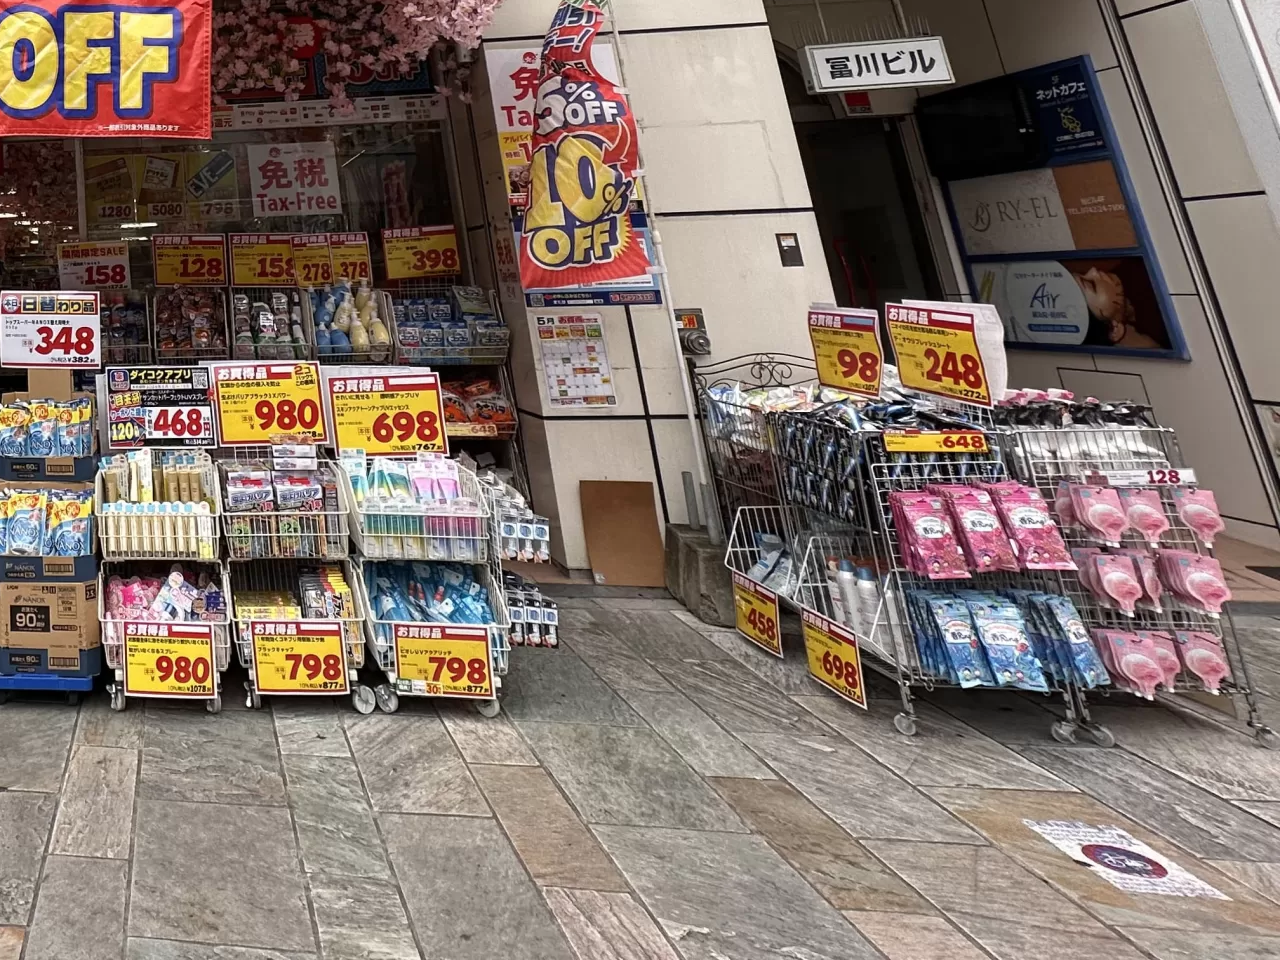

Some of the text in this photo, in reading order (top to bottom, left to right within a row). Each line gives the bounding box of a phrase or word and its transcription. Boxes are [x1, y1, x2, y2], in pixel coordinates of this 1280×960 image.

[1036, 82, 1086, 101] ネットカフェ
[258, 159, 329, 191] 免税
[256, 192, 337, 214] Tax-Free
[999, 196, 1058, 223] RY-EL
[530, 215, 619, 268] OFF
[179, 258, 222, 278] 128
[340, 261, 368, 279] 378
[412, 248, 458, 271] 398
[85, 265, 126, 286] 158
[303, 263, 331, 282] 278
[23, 296, 94, 312] 日替わり品
[1029, 282, 1060, 309] Air
[809, 314, 841, 328] お買得品
[888, 308, 928, 325] お買得品
[35, 326, 95, 355] 348
[130, 369, 191, 380] ダイコクアプリ
[218, 366, 267, 379] お買得品
[837, 349, 879, 383] 98
[924, 347, 982, 390] 248
[333, 378, 385, 392] お買得品
[154, 408, 202, 436] 468
[255, 399, 319, 431] 980
[373, 411, 439, 443] 698
[942, 435, 984, 448] 648
[1147, 470, 1181, 484] 128
[16, 613, 37, 628] 90
[127, 624, 168, 636] お買得品
[255, 624, 297, 634] お買得品
[748, 607, 776, 641] 458
[397, 627, 441, 638] お買得品
[156, 656, 209, 684] 980
[285, 654, 341, 680] 798
[429, 657, 486, 684] 798
[823, 650, 858, 690] 698
